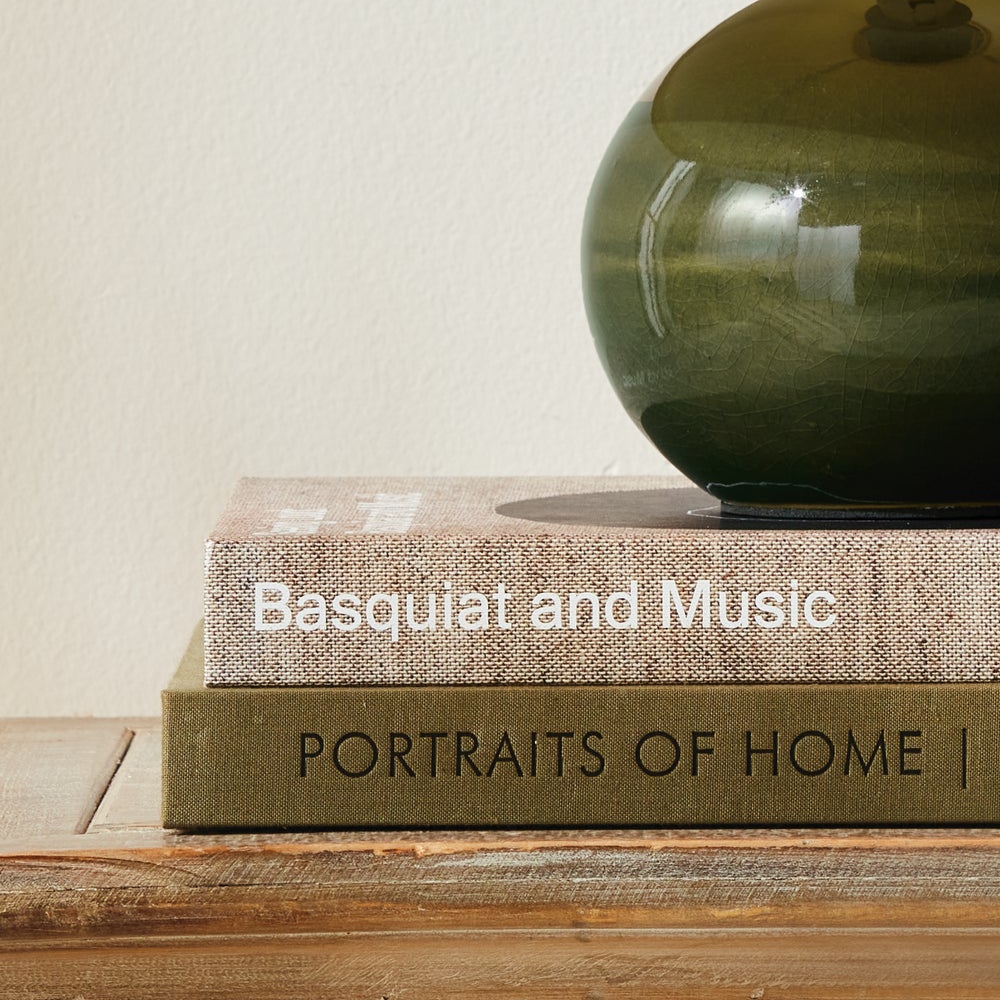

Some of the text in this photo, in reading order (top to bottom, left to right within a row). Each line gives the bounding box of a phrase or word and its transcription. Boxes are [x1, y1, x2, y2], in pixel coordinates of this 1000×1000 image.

[253, 579, 838, 642] Basquiat and Music
[300, 731, 606, 778] PORTRAITS
[635, 731, 716, 778] OF
[744, 729, 923, 777] HOME
